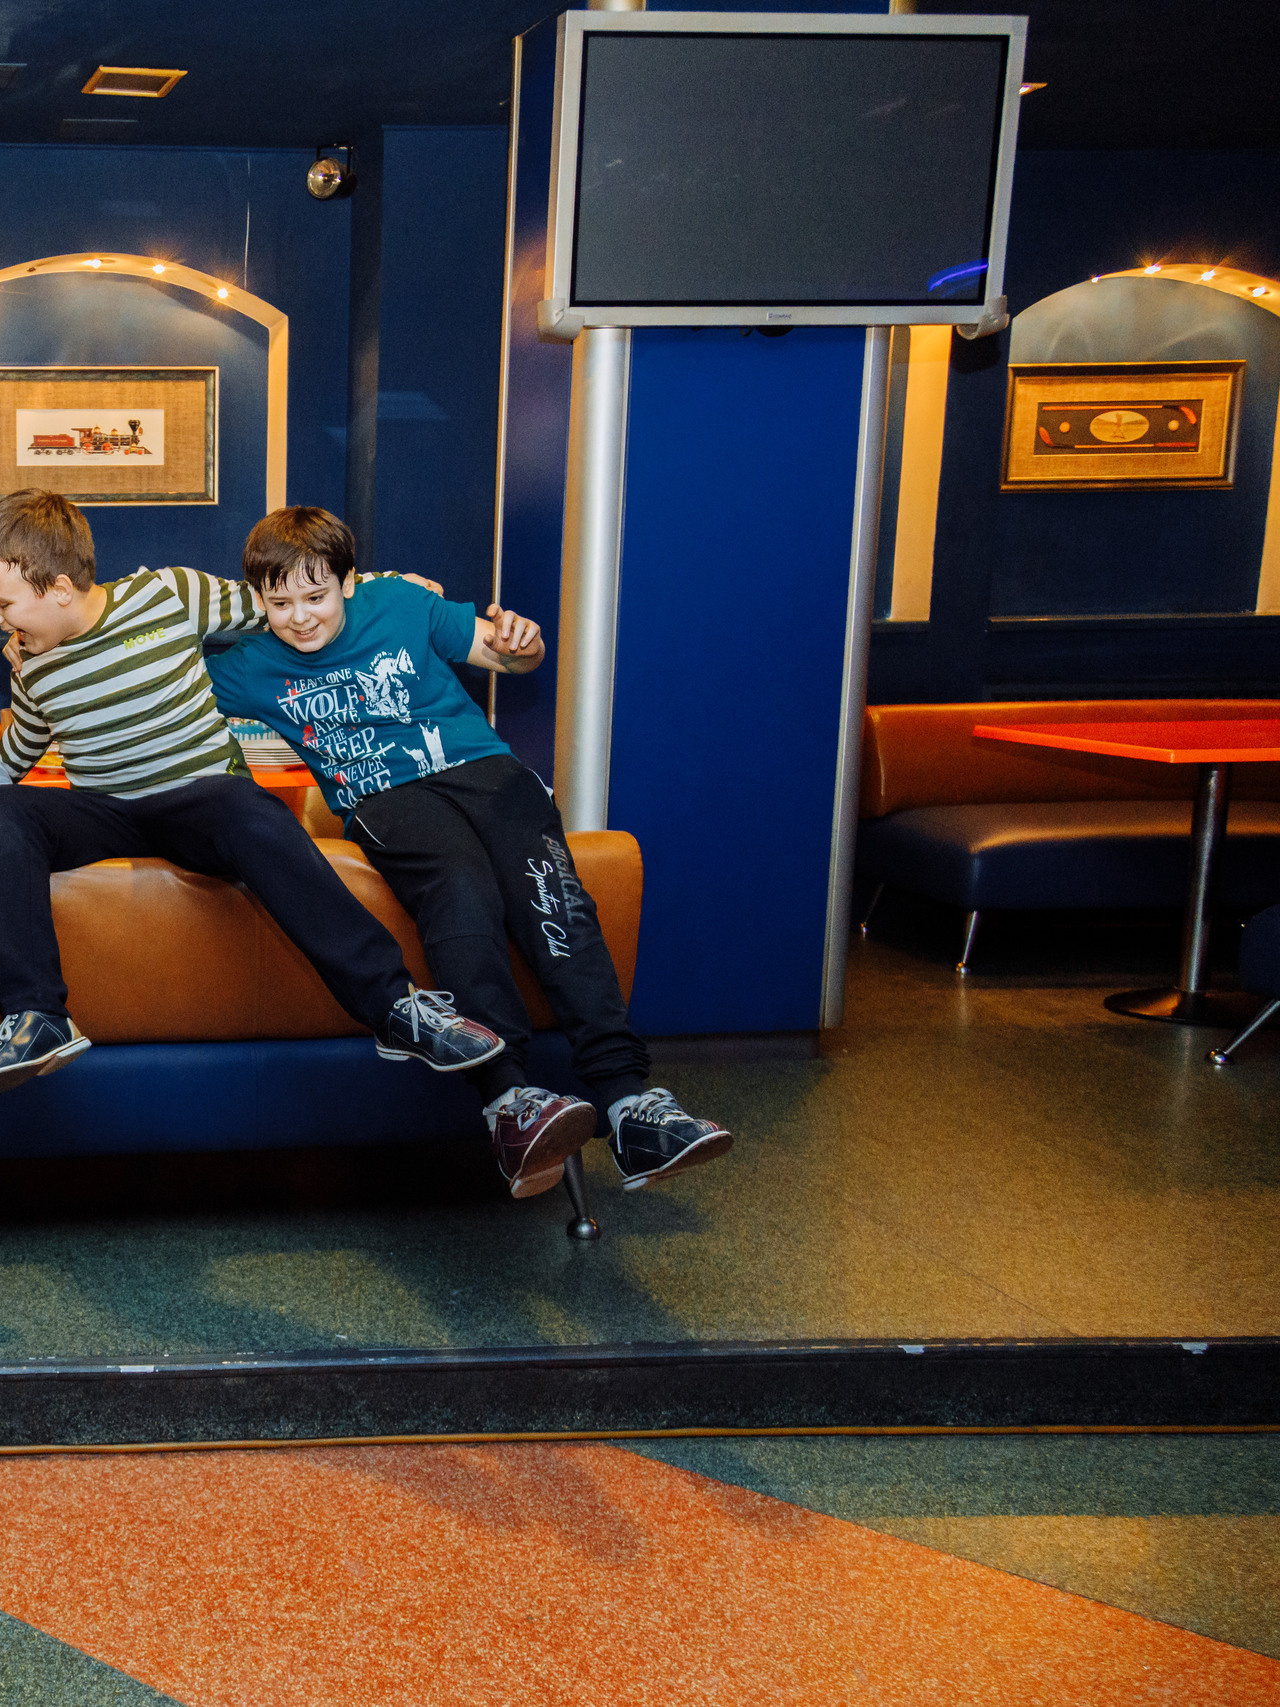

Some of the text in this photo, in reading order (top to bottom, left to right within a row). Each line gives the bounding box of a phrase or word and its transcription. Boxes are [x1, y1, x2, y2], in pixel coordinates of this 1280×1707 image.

[123, 627, 167, 651] MOVE
[294, 667, 353, 694] LEAVE ONE
[280, 684, 360, 725] WOLF
[313, 709, 362, 737] ALIVE
[303, 728, 347, 751] ND THE
[339, 755, 386, 785] NEVER
[525, 858, 571, 957] Sporting Club
